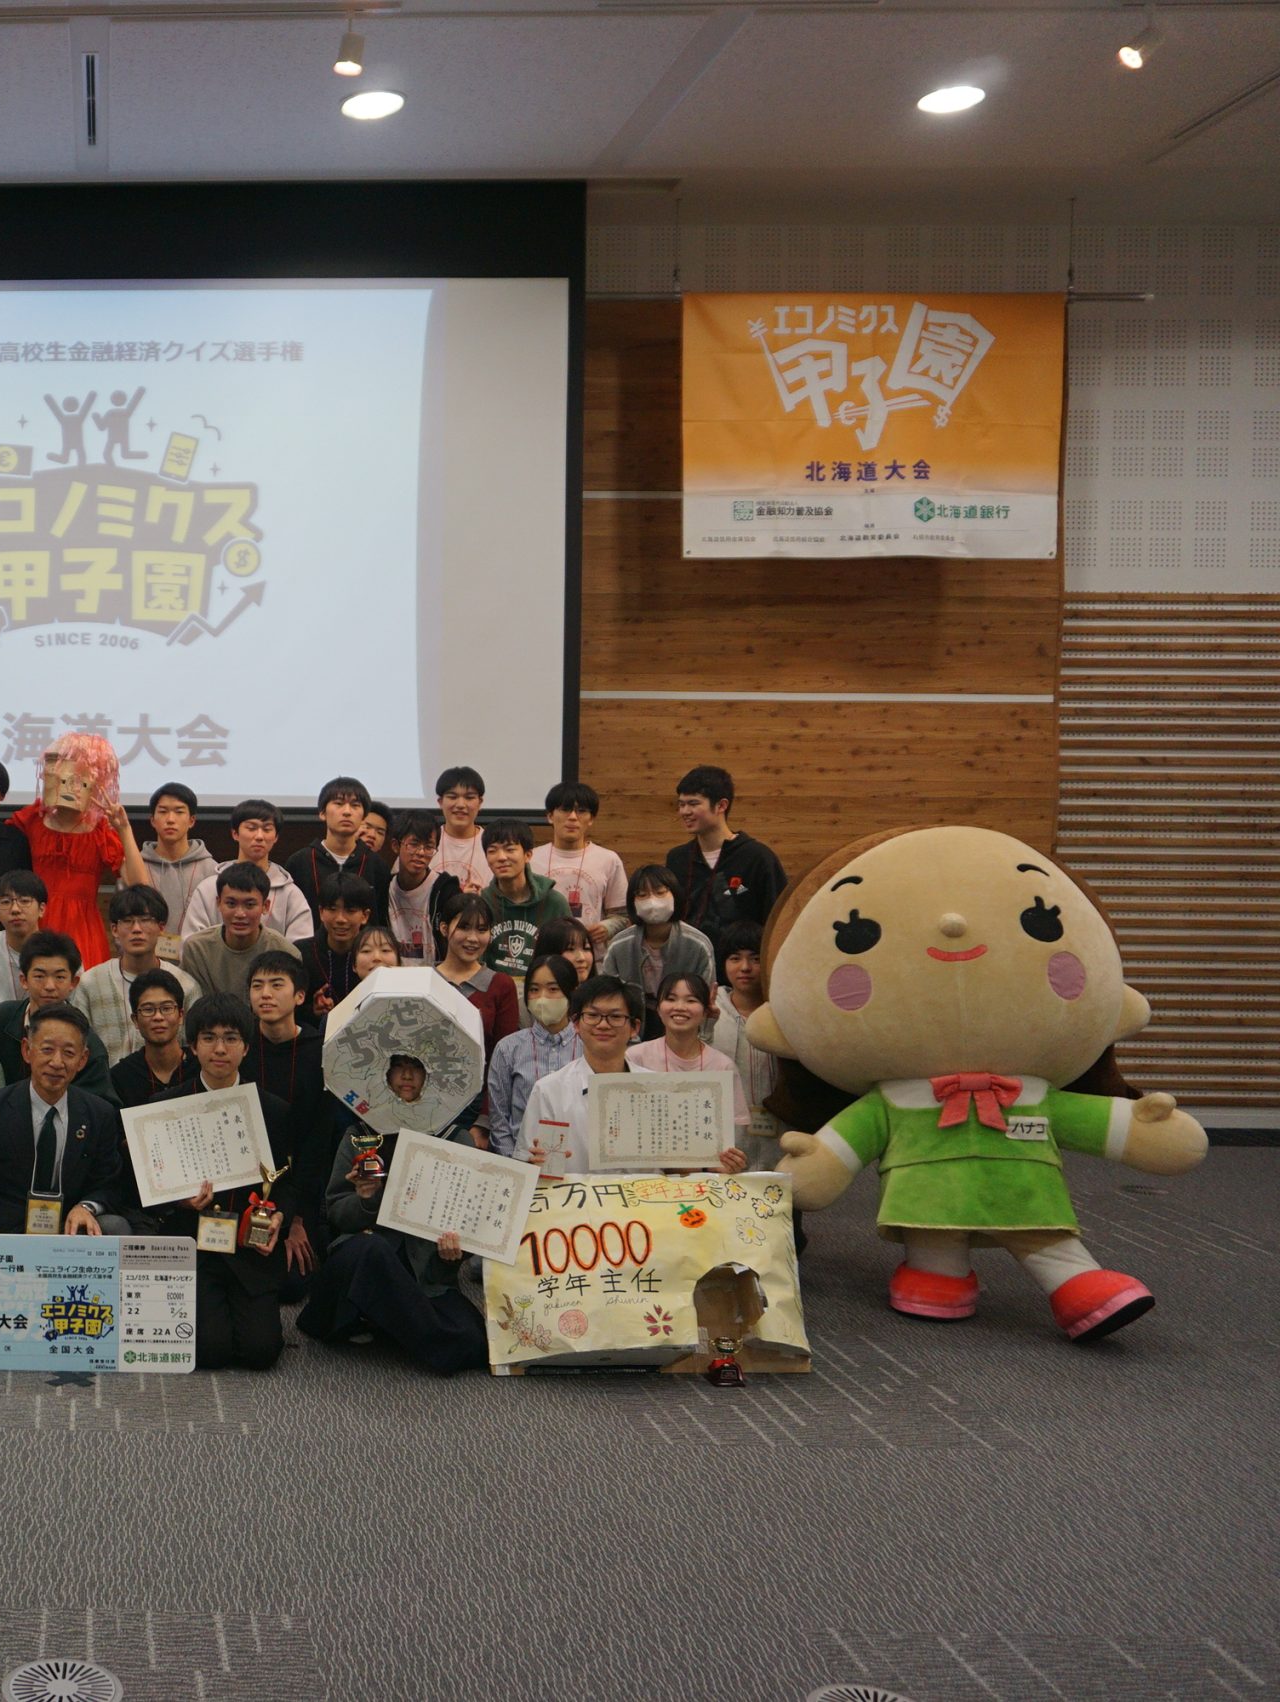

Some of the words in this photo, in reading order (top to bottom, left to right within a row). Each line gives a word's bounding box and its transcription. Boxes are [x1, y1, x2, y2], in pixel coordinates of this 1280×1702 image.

[773, 305, 898, 334] エコノミクス
[773, 301, 996, 451] 甲子園
[805, 459, 931, 482] 北海道大会
[936, 504, 1011, 519] 北海道銀行
[34, 633, 92, 648] SINCE
[98, 633, 140, 650] 2006
[703, 1100, 713, 1140] 表彰状
[1012, 1122, 1045, 1134] ハナコ
[235, 1114, 250, 1155] 表彰状
[493, 1188, 511, 1229] 表彰状
[520, 1219, 653, 1277] 10000
[35, 1265, 114, 1273] マニュライフ生命カップ
[537, 1268, 663, 1299] 学年主任
[41, 1304, 113, 1319] エコノミクス
[53, 1318, 102, 1335] 甲子園
[49, 1345, 95, 1354] 全国大会
[137, 1352, 192, 1363] 北海道銀行
